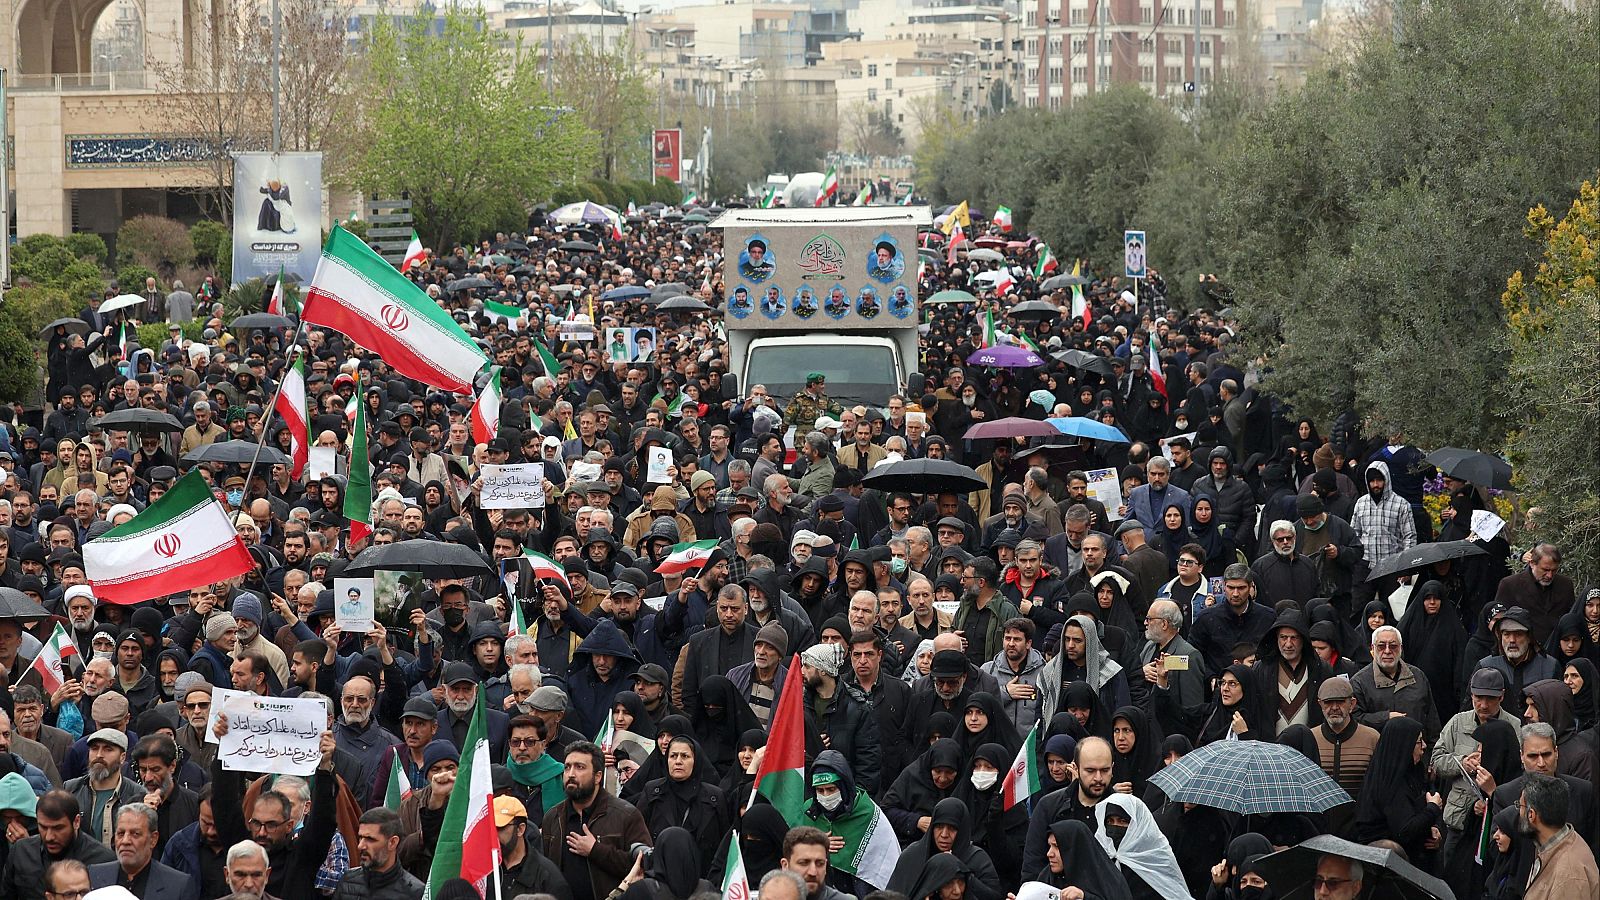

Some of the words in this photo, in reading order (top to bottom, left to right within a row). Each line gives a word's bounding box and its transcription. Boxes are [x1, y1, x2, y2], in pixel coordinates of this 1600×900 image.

[232, 715, 251, 731] افتاد
[250, 717, 277, 736] کردن
[275, 718, 290, 734] غلط
[297, 720, 318, 739] ترامپ
[289, 728, 297, 738] به
